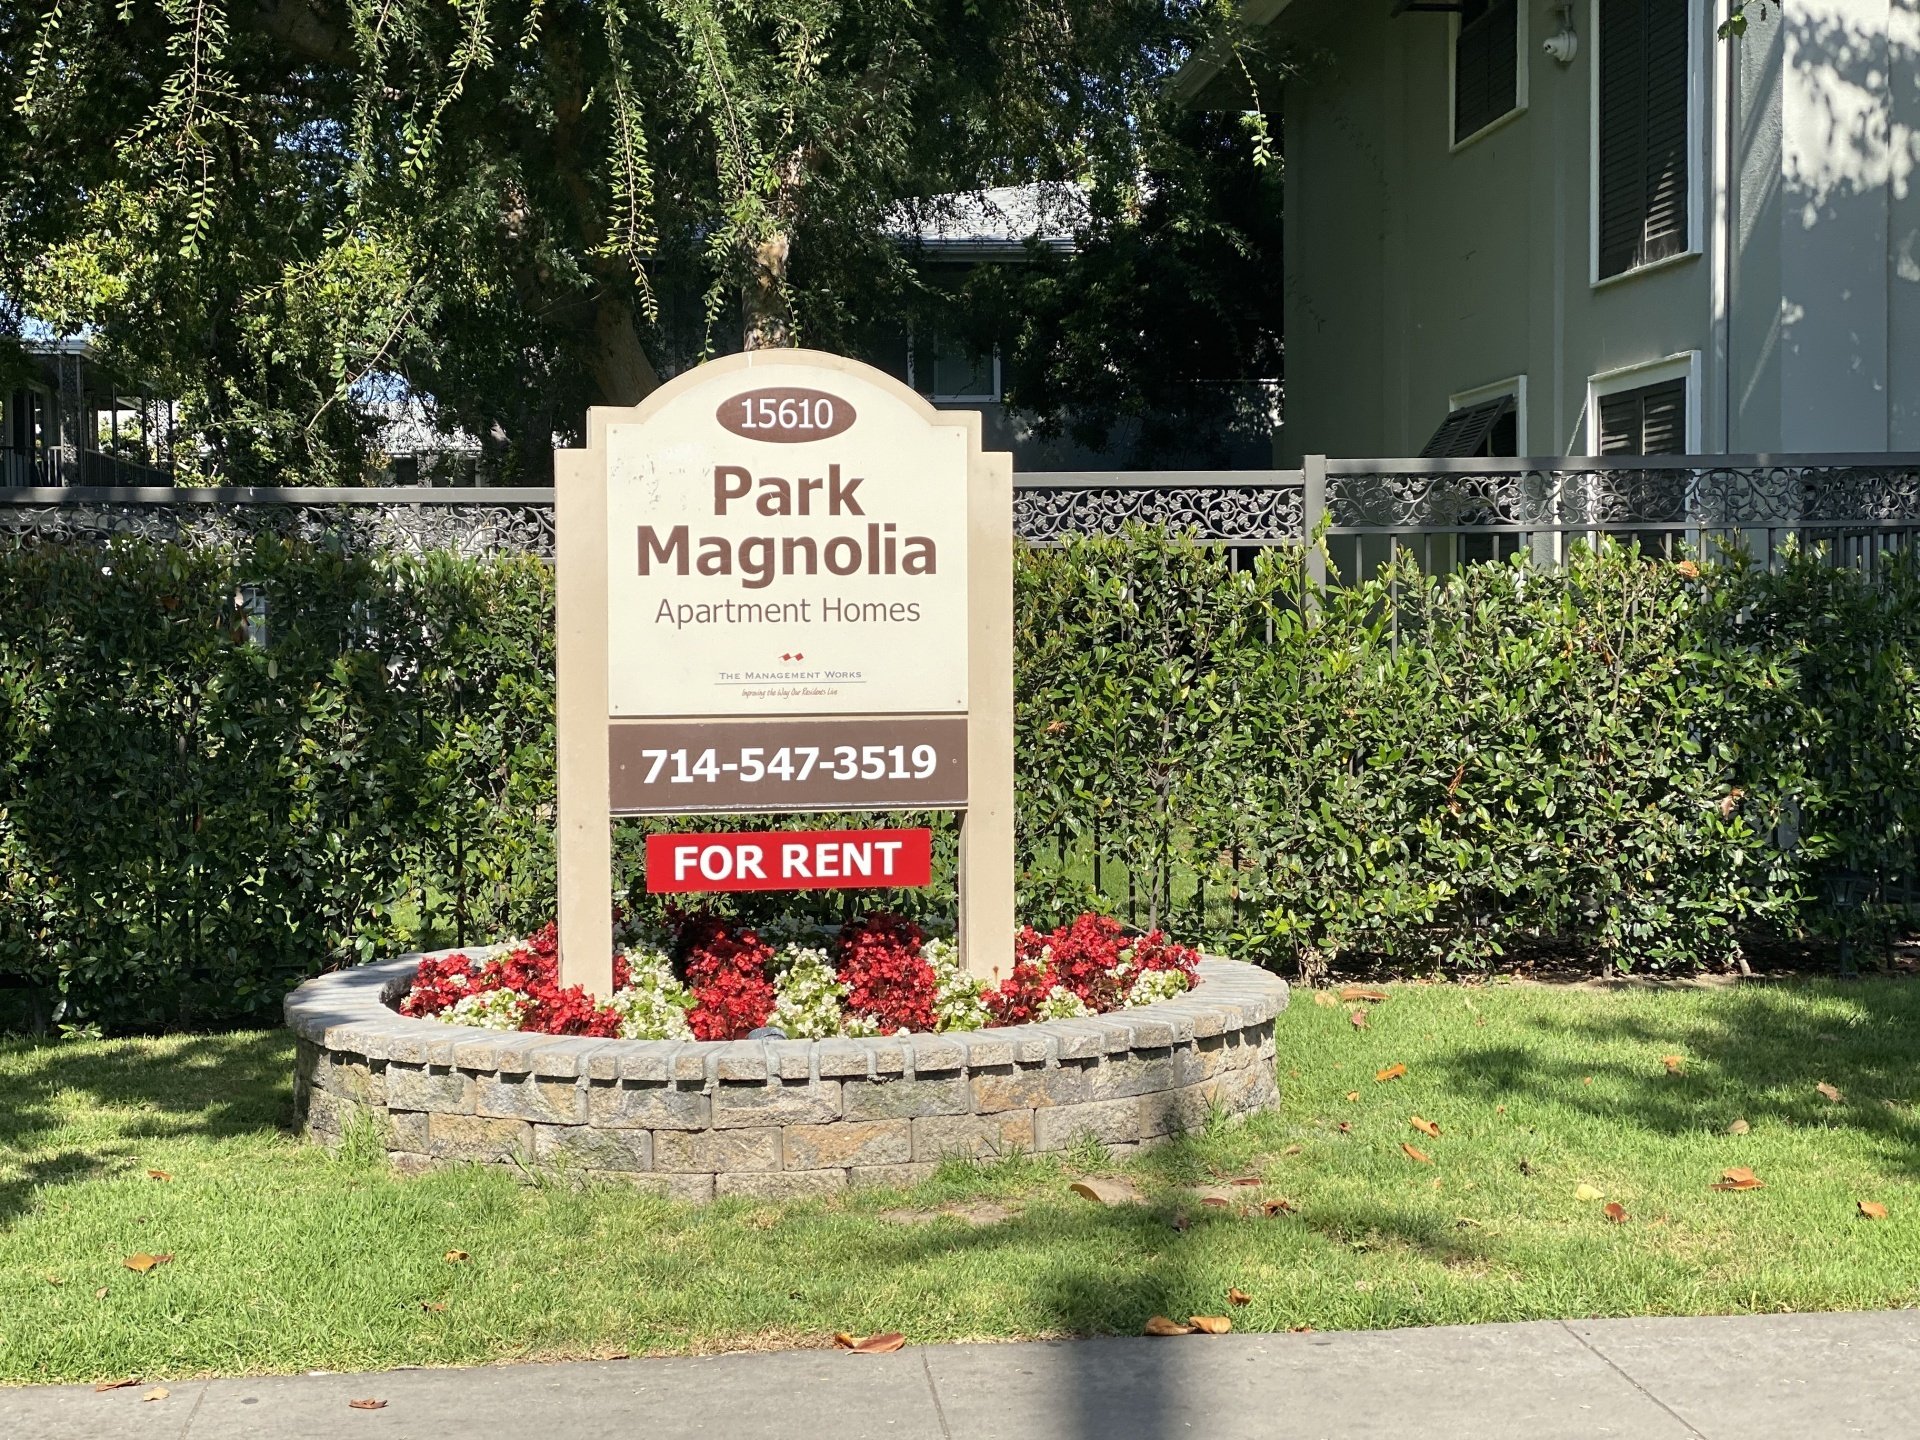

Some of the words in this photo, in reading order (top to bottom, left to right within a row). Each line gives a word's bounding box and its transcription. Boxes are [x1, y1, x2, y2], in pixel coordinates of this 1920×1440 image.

[741, 398, 834, 430] 15610
[714, 463, 866, 517] Park
[637, 523, 937, 590] Magnolia
[655, 597, 811, 630] Apartment
[822, 596, 921, 623] Homes
[641, 744, 938, 785] 714-547-3519
[674, 843, 768, 881] FOR
[782, 840, 903, 878] RENT
